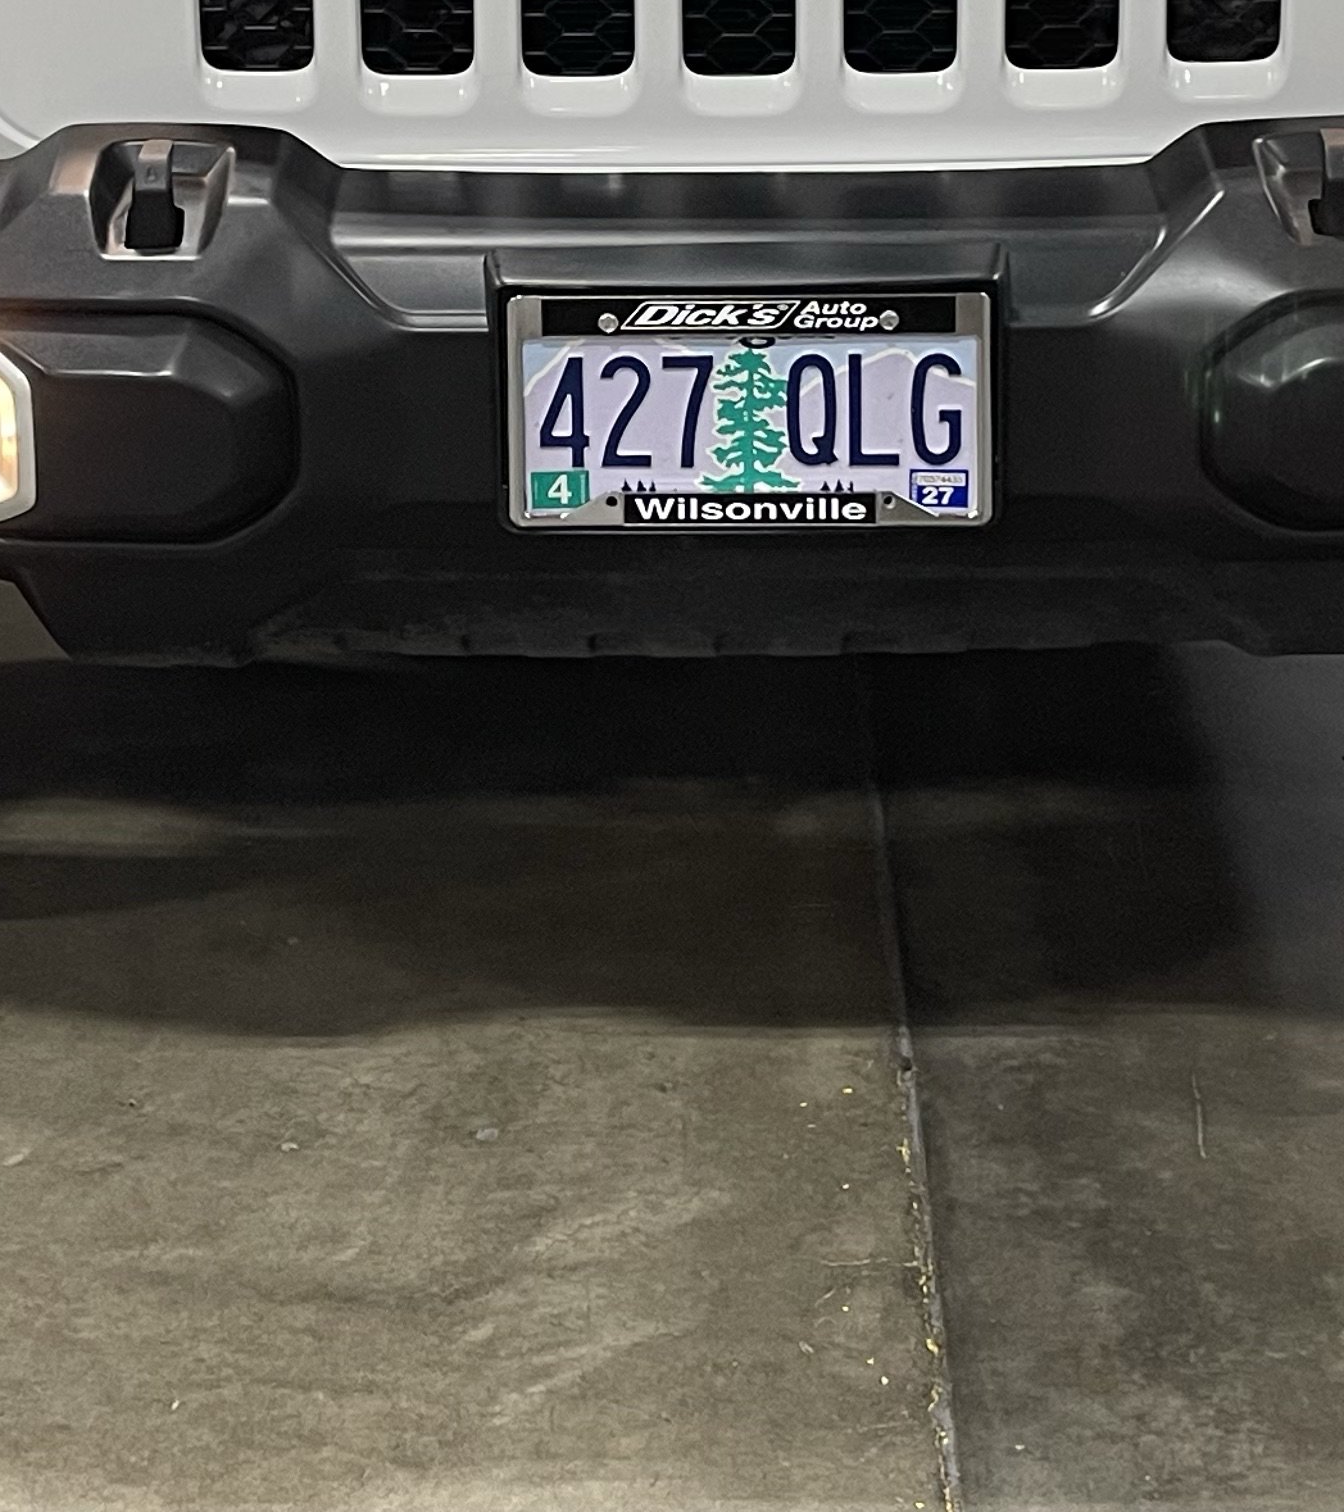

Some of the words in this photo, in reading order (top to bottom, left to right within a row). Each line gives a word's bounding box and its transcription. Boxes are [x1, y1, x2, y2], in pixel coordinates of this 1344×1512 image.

[634, 303, 781, 327] Dick's
[799, 300, 867, 316] Auto
[793, 313, 880, 332] Group
[539, 354, 714, 468] 427
[786, 352, 963, 467] QLG
[547, 474, 573, 505] 4
[921, 485, 955, 505] 27
[633, 497, 868, 521] Wilsonville
